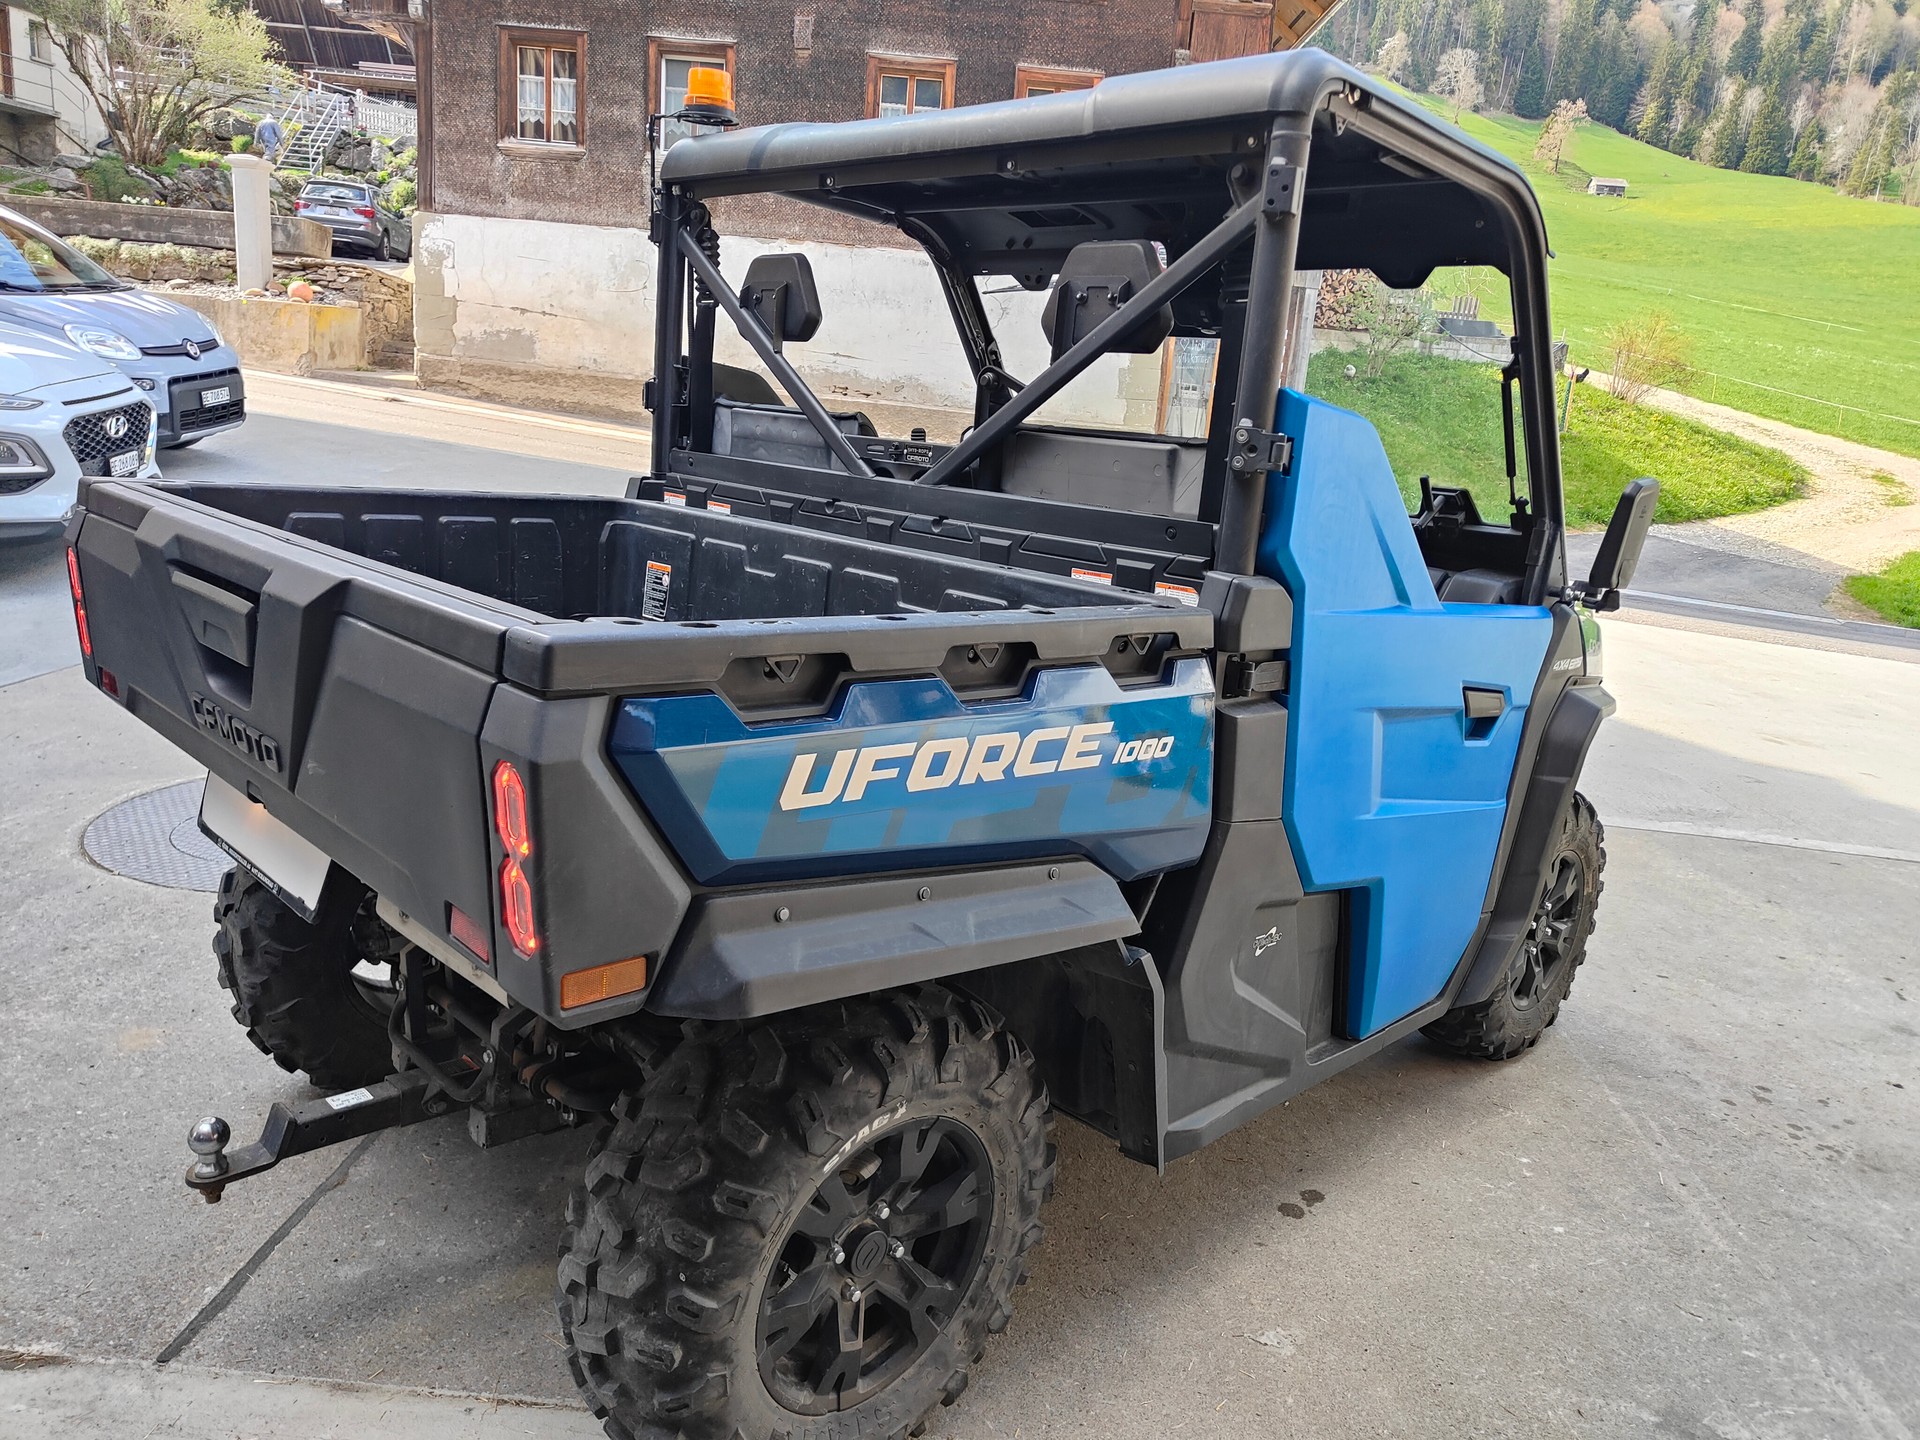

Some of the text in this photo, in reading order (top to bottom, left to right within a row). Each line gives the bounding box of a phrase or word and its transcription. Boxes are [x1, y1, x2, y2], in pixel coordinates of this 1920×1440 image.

[191, 691, 282, 773] CFMOTO
[779, 721, 1175, 812] UFORCE 1000
